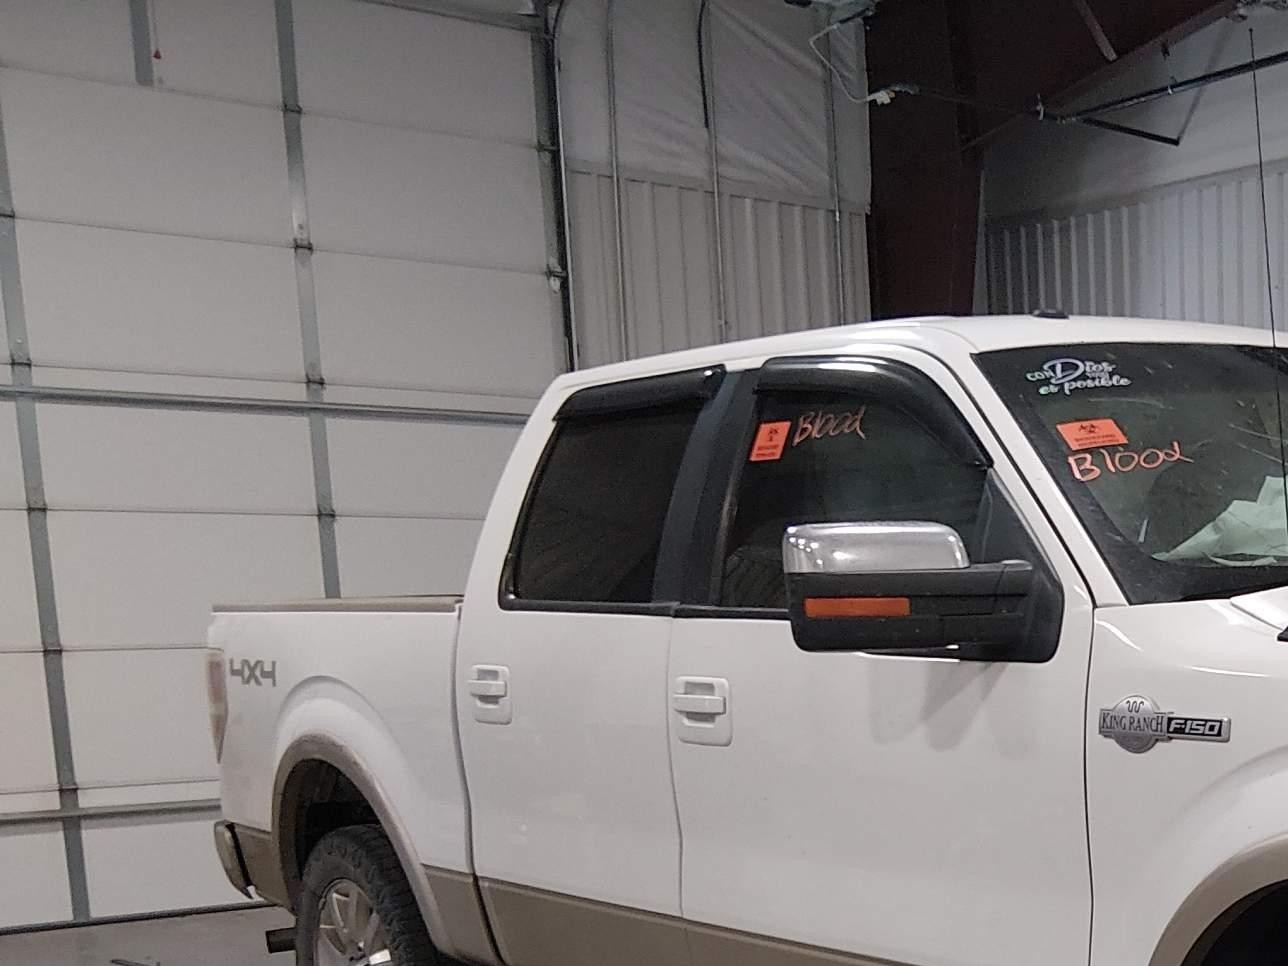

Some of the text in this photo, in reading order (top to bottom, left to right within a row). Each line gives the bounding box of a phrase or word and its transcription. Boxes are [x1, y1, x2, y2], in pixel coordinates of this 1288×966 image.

[792, 405, 867, 447] Blood
[1067, 440, 1195, 482] Blood
[1128, 714, 1165, 734] RANCH
